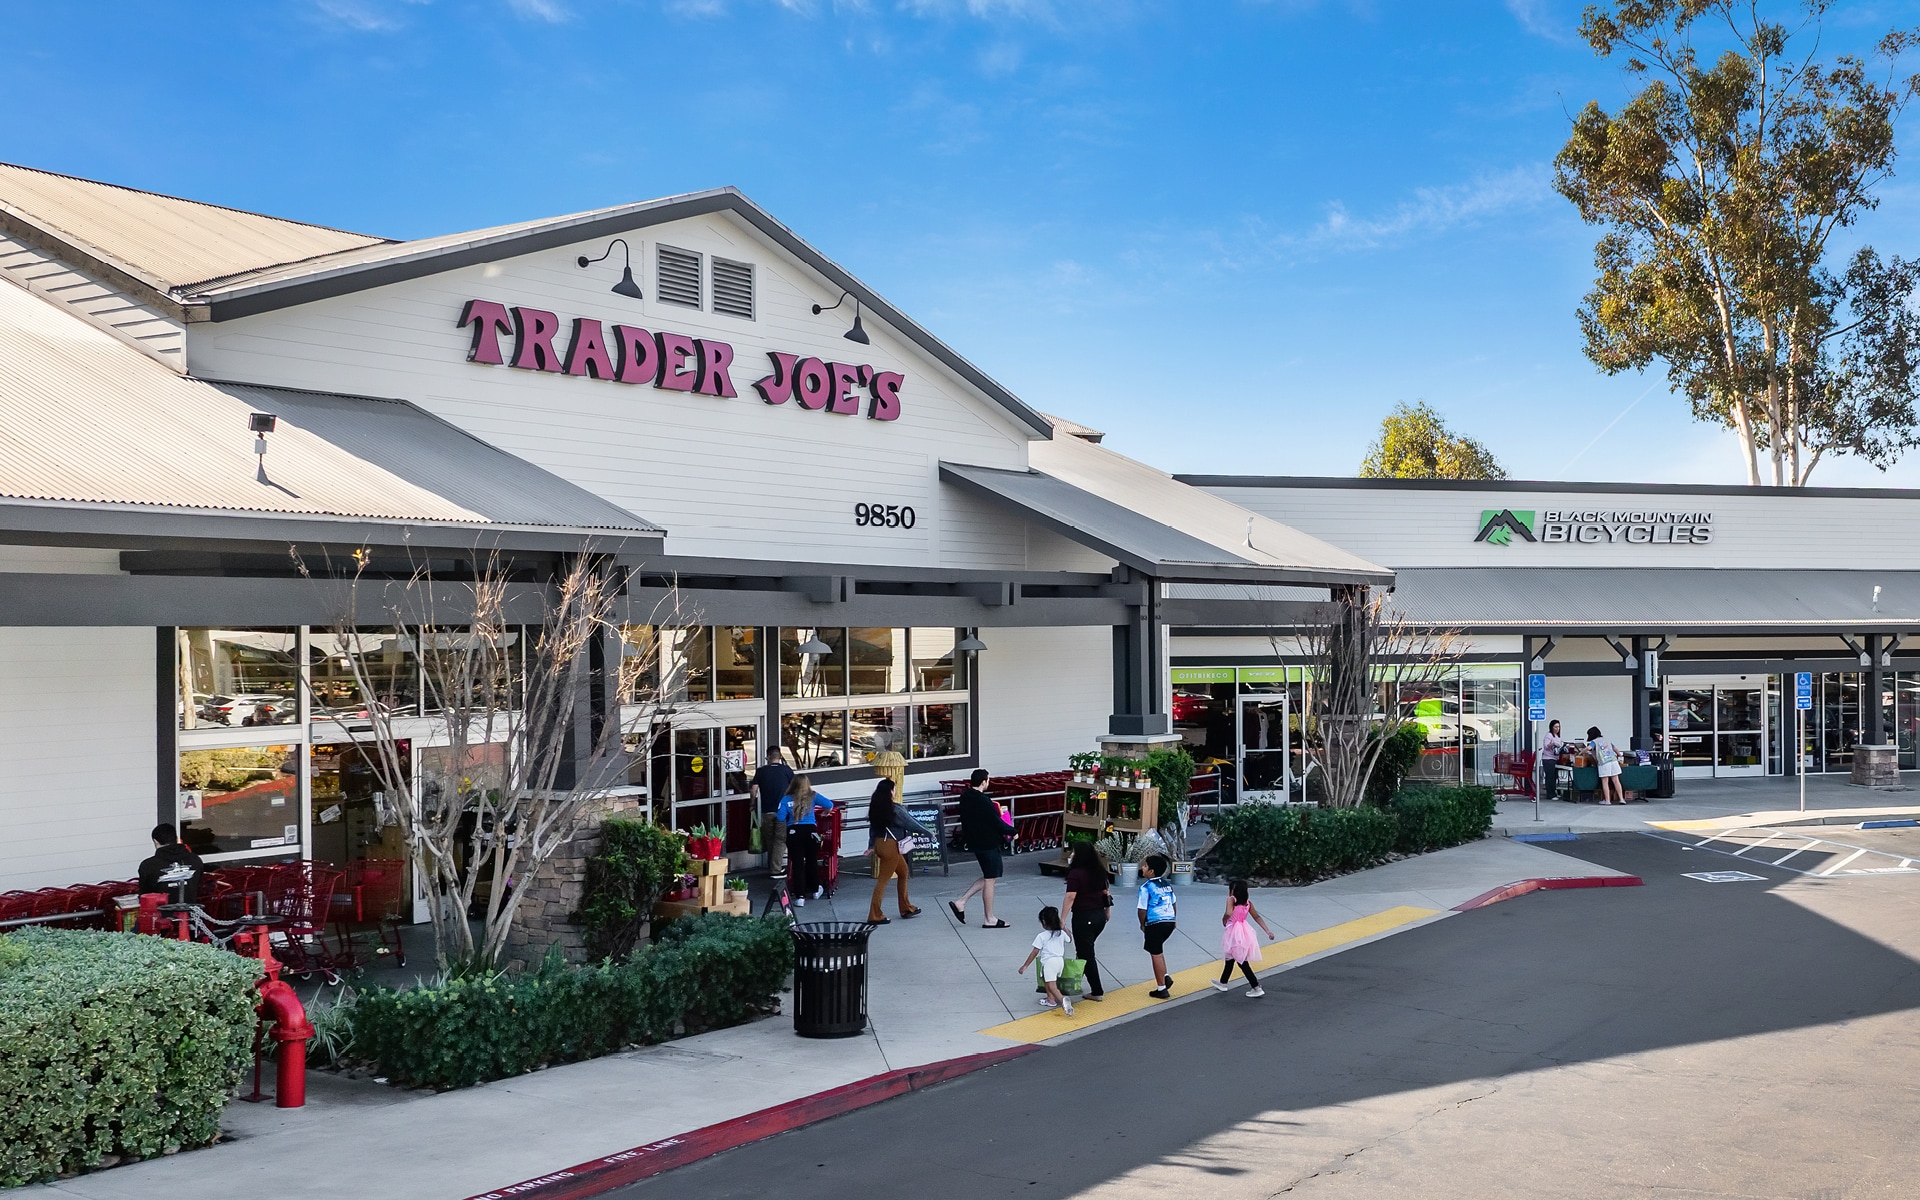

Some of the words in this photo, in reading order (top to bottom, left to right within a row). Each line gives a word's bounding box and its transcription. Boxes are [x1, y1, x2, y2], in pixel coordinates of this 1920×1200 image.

[457, 300, 738, 398] TRADER
[751, 351, 905, 421] JOE'S
[855, 503, 915, 529] 9850
[1545, 511, 1608, 522] BLACK
[1613, 512, 1713, 523] MOUNTAIN
[1542, 523, 1715, 544] BICYCLES
[185, 795, 197, 808] A
[503, 1171, 575, 1194] PARKING
[603, 1150, 644, 1163] FIRE
[643, 1138, 686, 1151] LANE
